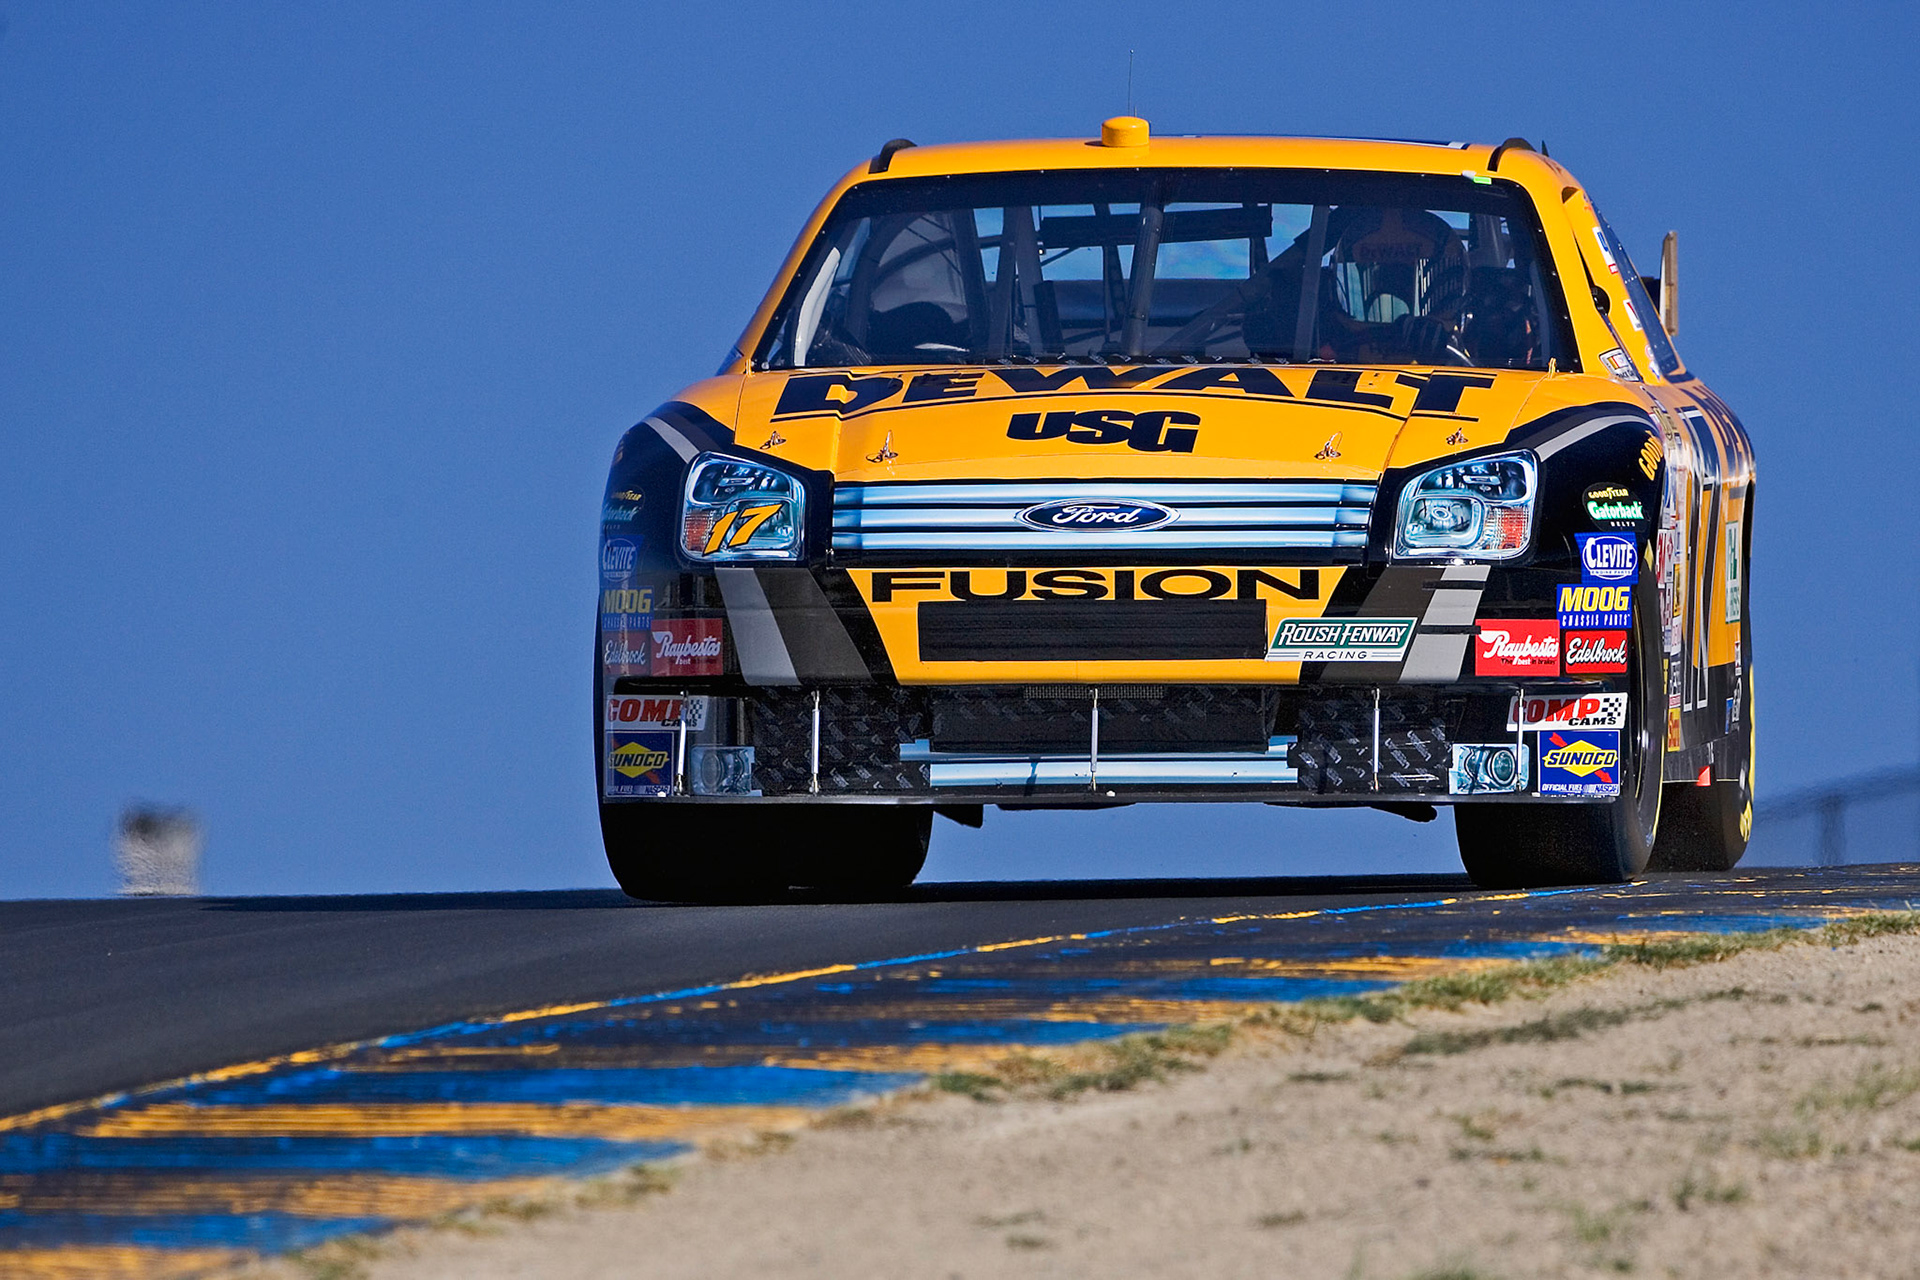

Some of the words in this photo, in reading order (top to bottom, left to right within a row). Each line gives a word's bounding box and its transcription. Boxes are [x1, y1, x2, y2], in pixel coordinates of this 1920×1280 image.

[772, 365, 1496, 417] DEWALT
[1005, 409, 1201, 454] USG
[1587, 486, 1629, 500] GOODYEAR
[1051, 504, 1140, 528] Ford
[1586, 500, 1644, 520] Gatorback
[702, 503, 783, 557] 17
[1585, 537, 1634, 569] CLEVITE
[871, 568, 1320, 603] FUSION
[602, 588, 653, 614] MOOG
[1558, 585, 1631, 613] MOOG
[1562, 613, 1600, 627] CHASSIS
[1604, 613, 1630, 627] PARTS
[1278, 623, 1342, 646] ROUSH
[1339, 623, 1408, 646] FENWAY
[604, 639, 647, 665] Edelbrock
[651, 630, 722, 665] Raybestos
[1303, 650, 1369, 660] RACING
[1565, 636, 1628, 665] Edelbrock
[1517, 657, 1531, 666] best
[1512, 698, 1601, 723] COMP
[1568, 716, 1617, 726] CAMS
[1547, 751, 1616, 766] SUNOCO
[1541, 783, 1568, 792] OFFICIAL
[1568, 783, 1584, 792] FUEL
